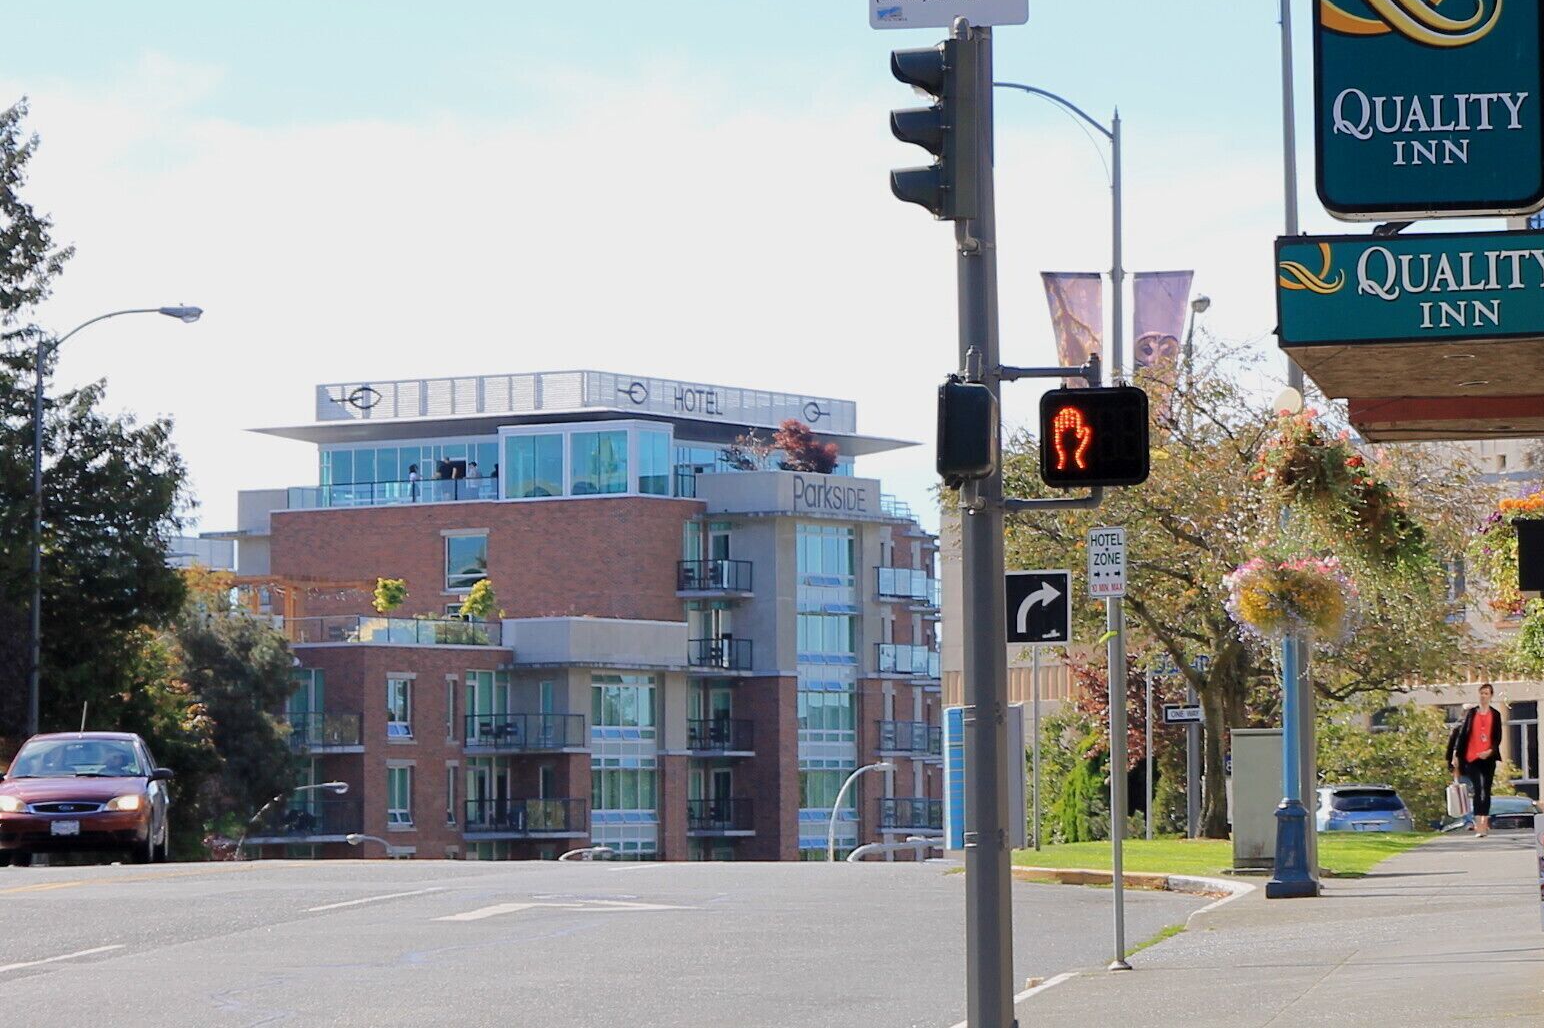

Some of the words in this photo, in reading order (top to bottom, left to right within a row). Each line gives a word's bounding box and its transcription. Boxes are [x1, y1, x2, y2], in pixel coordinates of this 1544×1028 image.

[1333, 87, 1529, 140] QUALITY
[1393, 139, 1470, 165] INN
[1420, 299, 1501, 328] INN
[673, 386, 723, 415] HOTEL
[1090, 533, 1123, 546] HOTEL
[1093, 552, 1121, 566] ZONE
